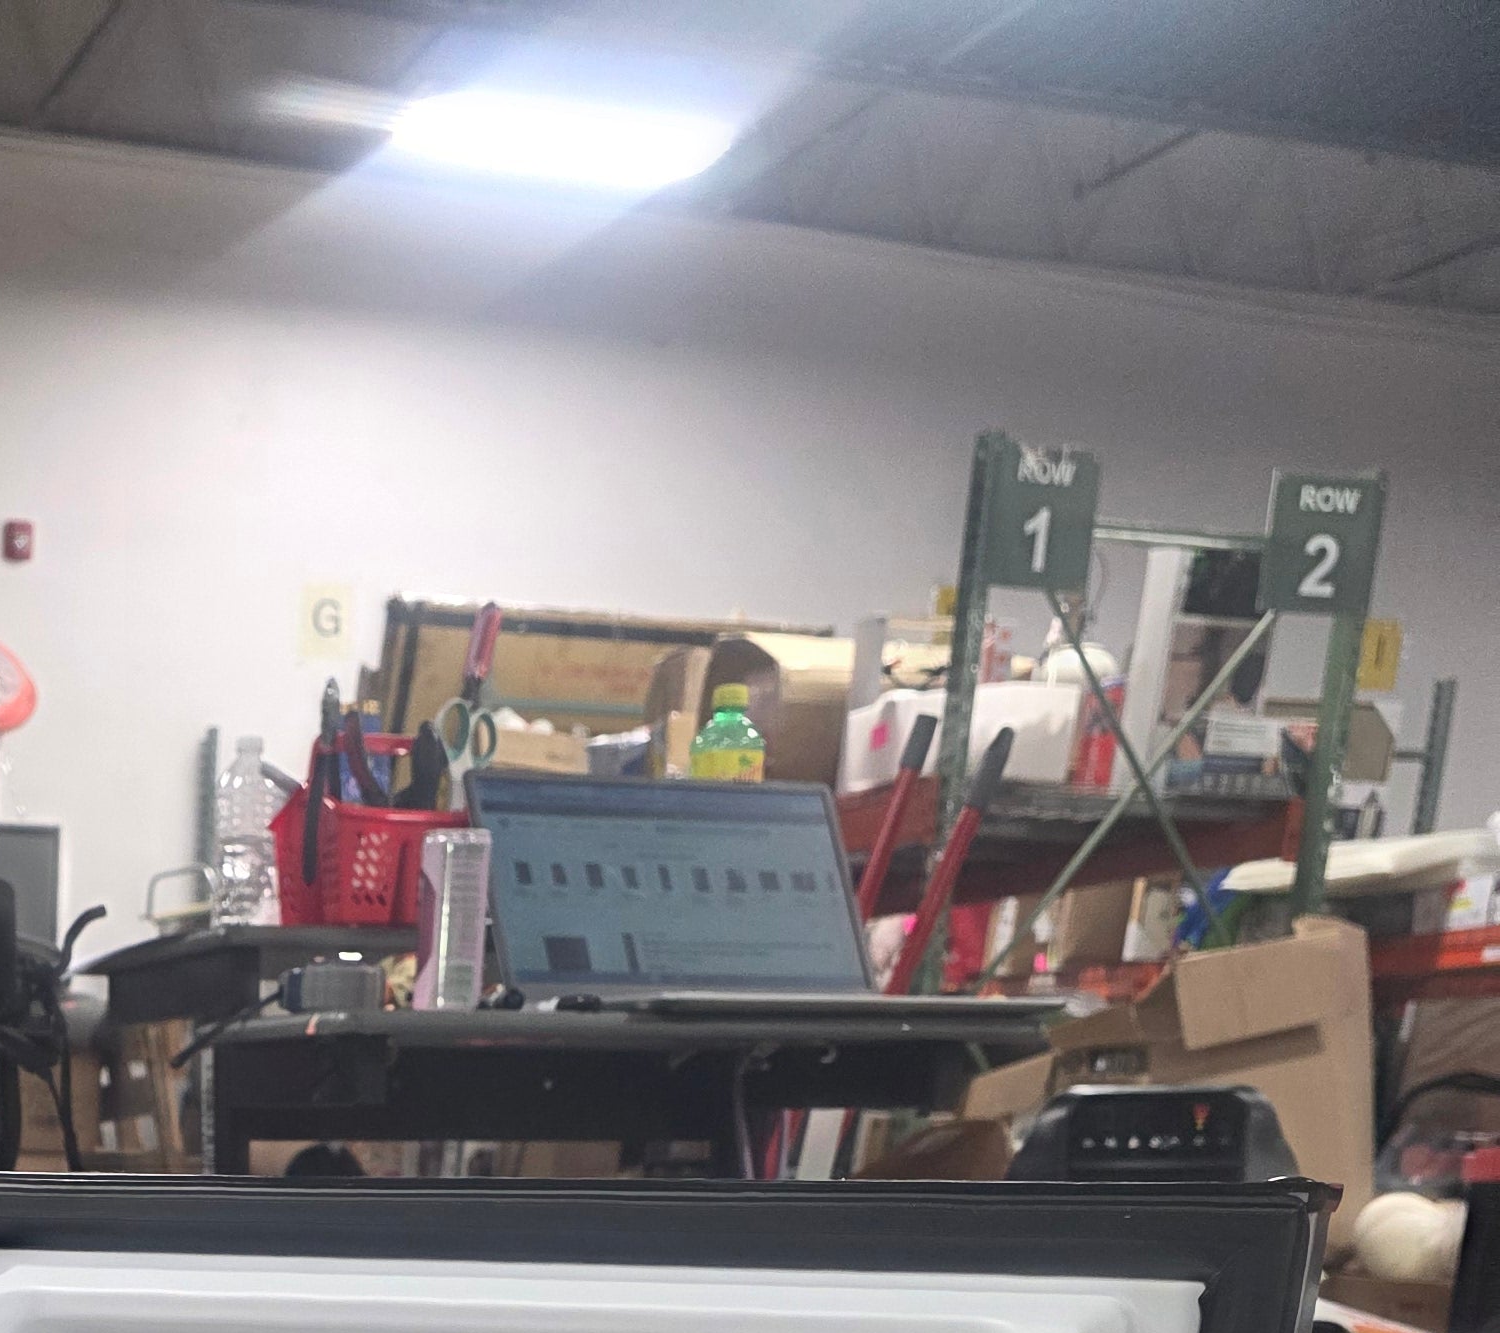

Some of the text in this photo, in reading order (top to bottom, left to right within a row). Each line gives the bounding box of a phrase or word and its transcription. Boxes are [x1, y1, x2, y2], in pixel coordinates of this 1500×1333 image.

[1017, 456, 1077, 488] ROW
[1299, 484, 1361, 515] ROW
[1024, 505, 1050, 573] 1
[1298, 534, 1340, 599] 2
[311, 598, 342, 638] G
